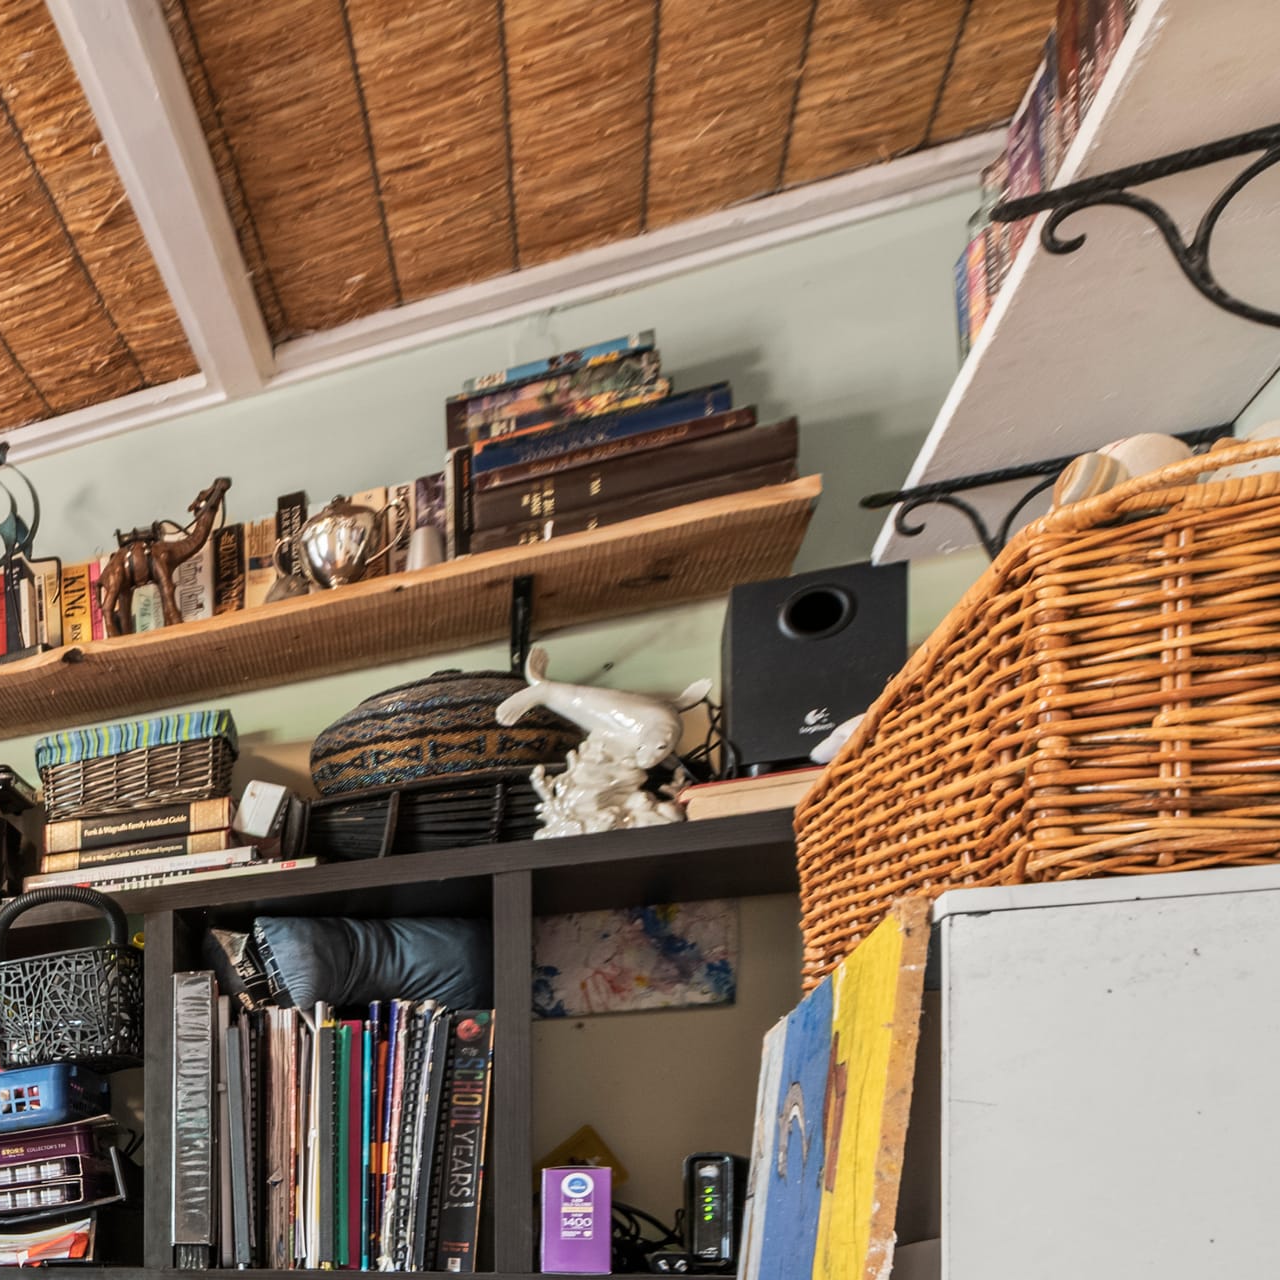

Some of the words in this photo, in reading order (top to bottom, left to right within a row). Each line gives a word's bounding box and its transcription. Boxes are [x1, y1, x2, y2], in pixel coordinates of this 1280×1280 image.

[64, 573, 86, 619] KING
[127, 820, 146, 832] Family
[146, 816, 169, 829] Medical
[169, 814, 188, 826] Guide
[449, 1057, 486, 1128] SCHOOL
[448, 1129, 478, 1199] YEARS
[561, 1217, 592, 1228] 1400
